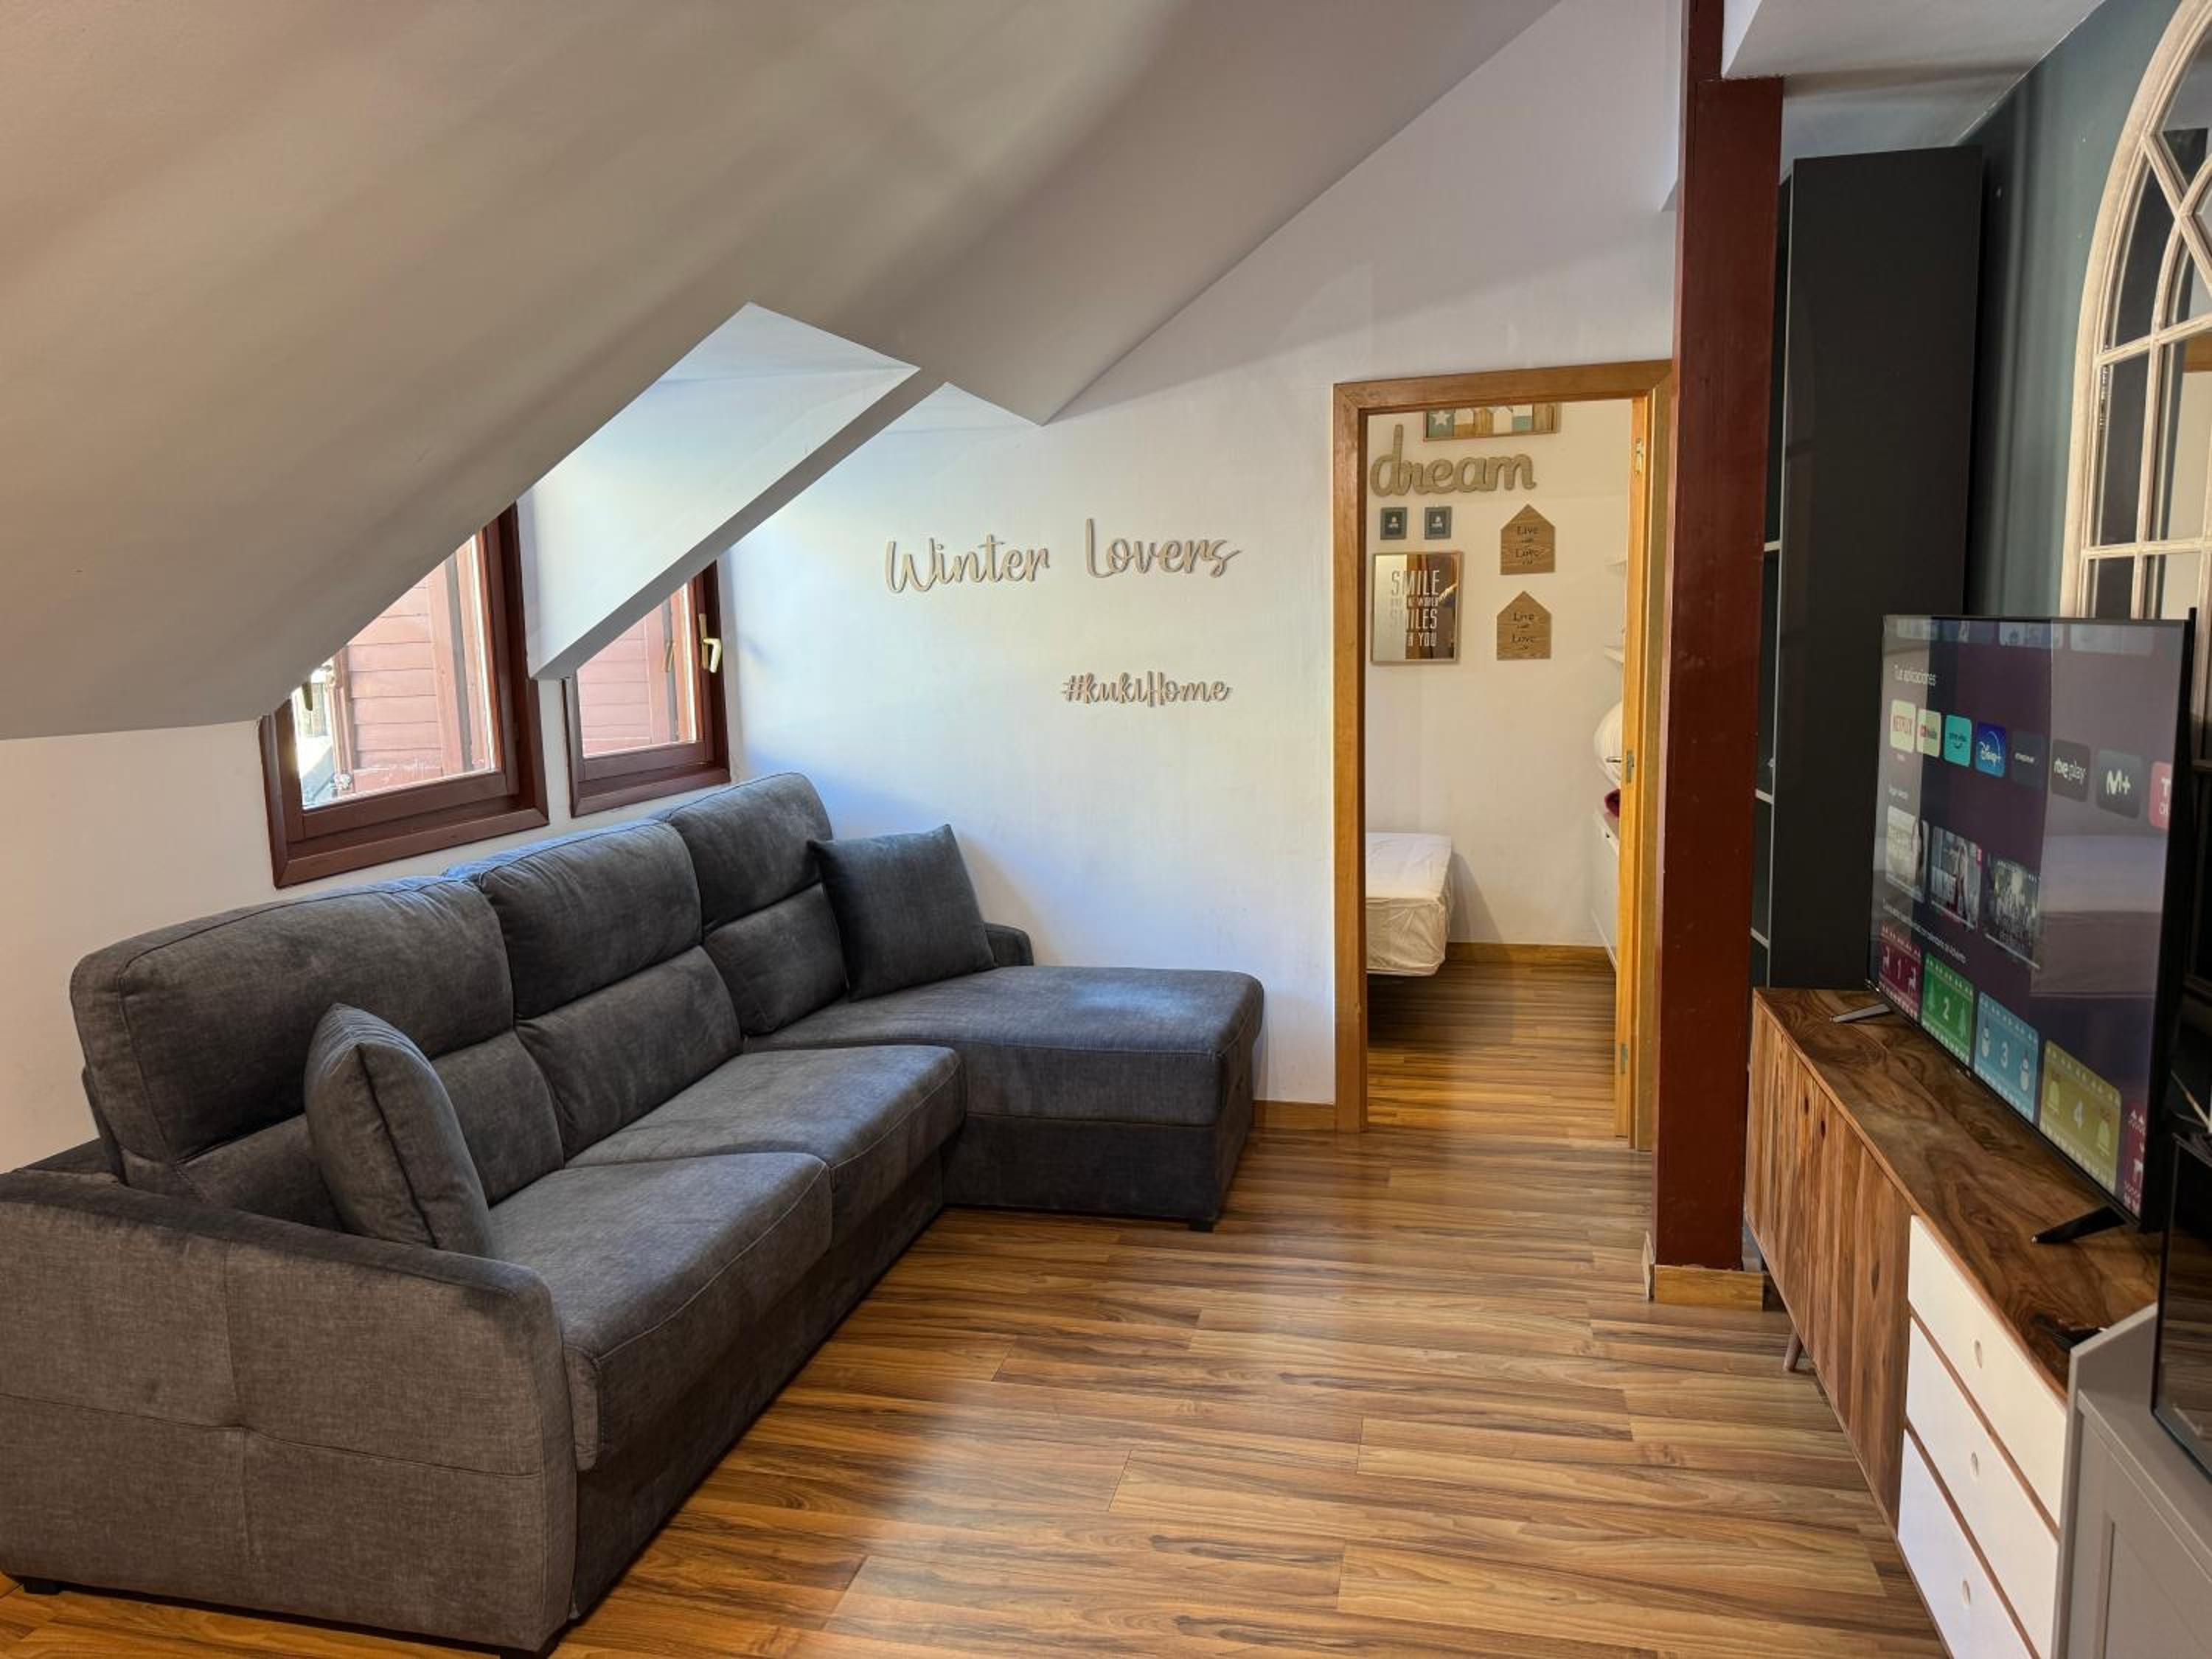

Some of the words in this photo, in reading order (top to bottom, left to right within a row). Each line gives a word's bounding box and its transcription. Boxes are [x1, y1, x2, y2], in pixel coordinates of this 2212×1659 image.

[1370, 424, 1537, 497] dream
[886, 534, 1050, 593] Winter
[1085, 518, 1242, 579] Lovers
[1391, 569, 1440, 596] SMILE
[1942, 998, 1950, 1020] 2
[2000, 1043, 2010, 1069] 3
